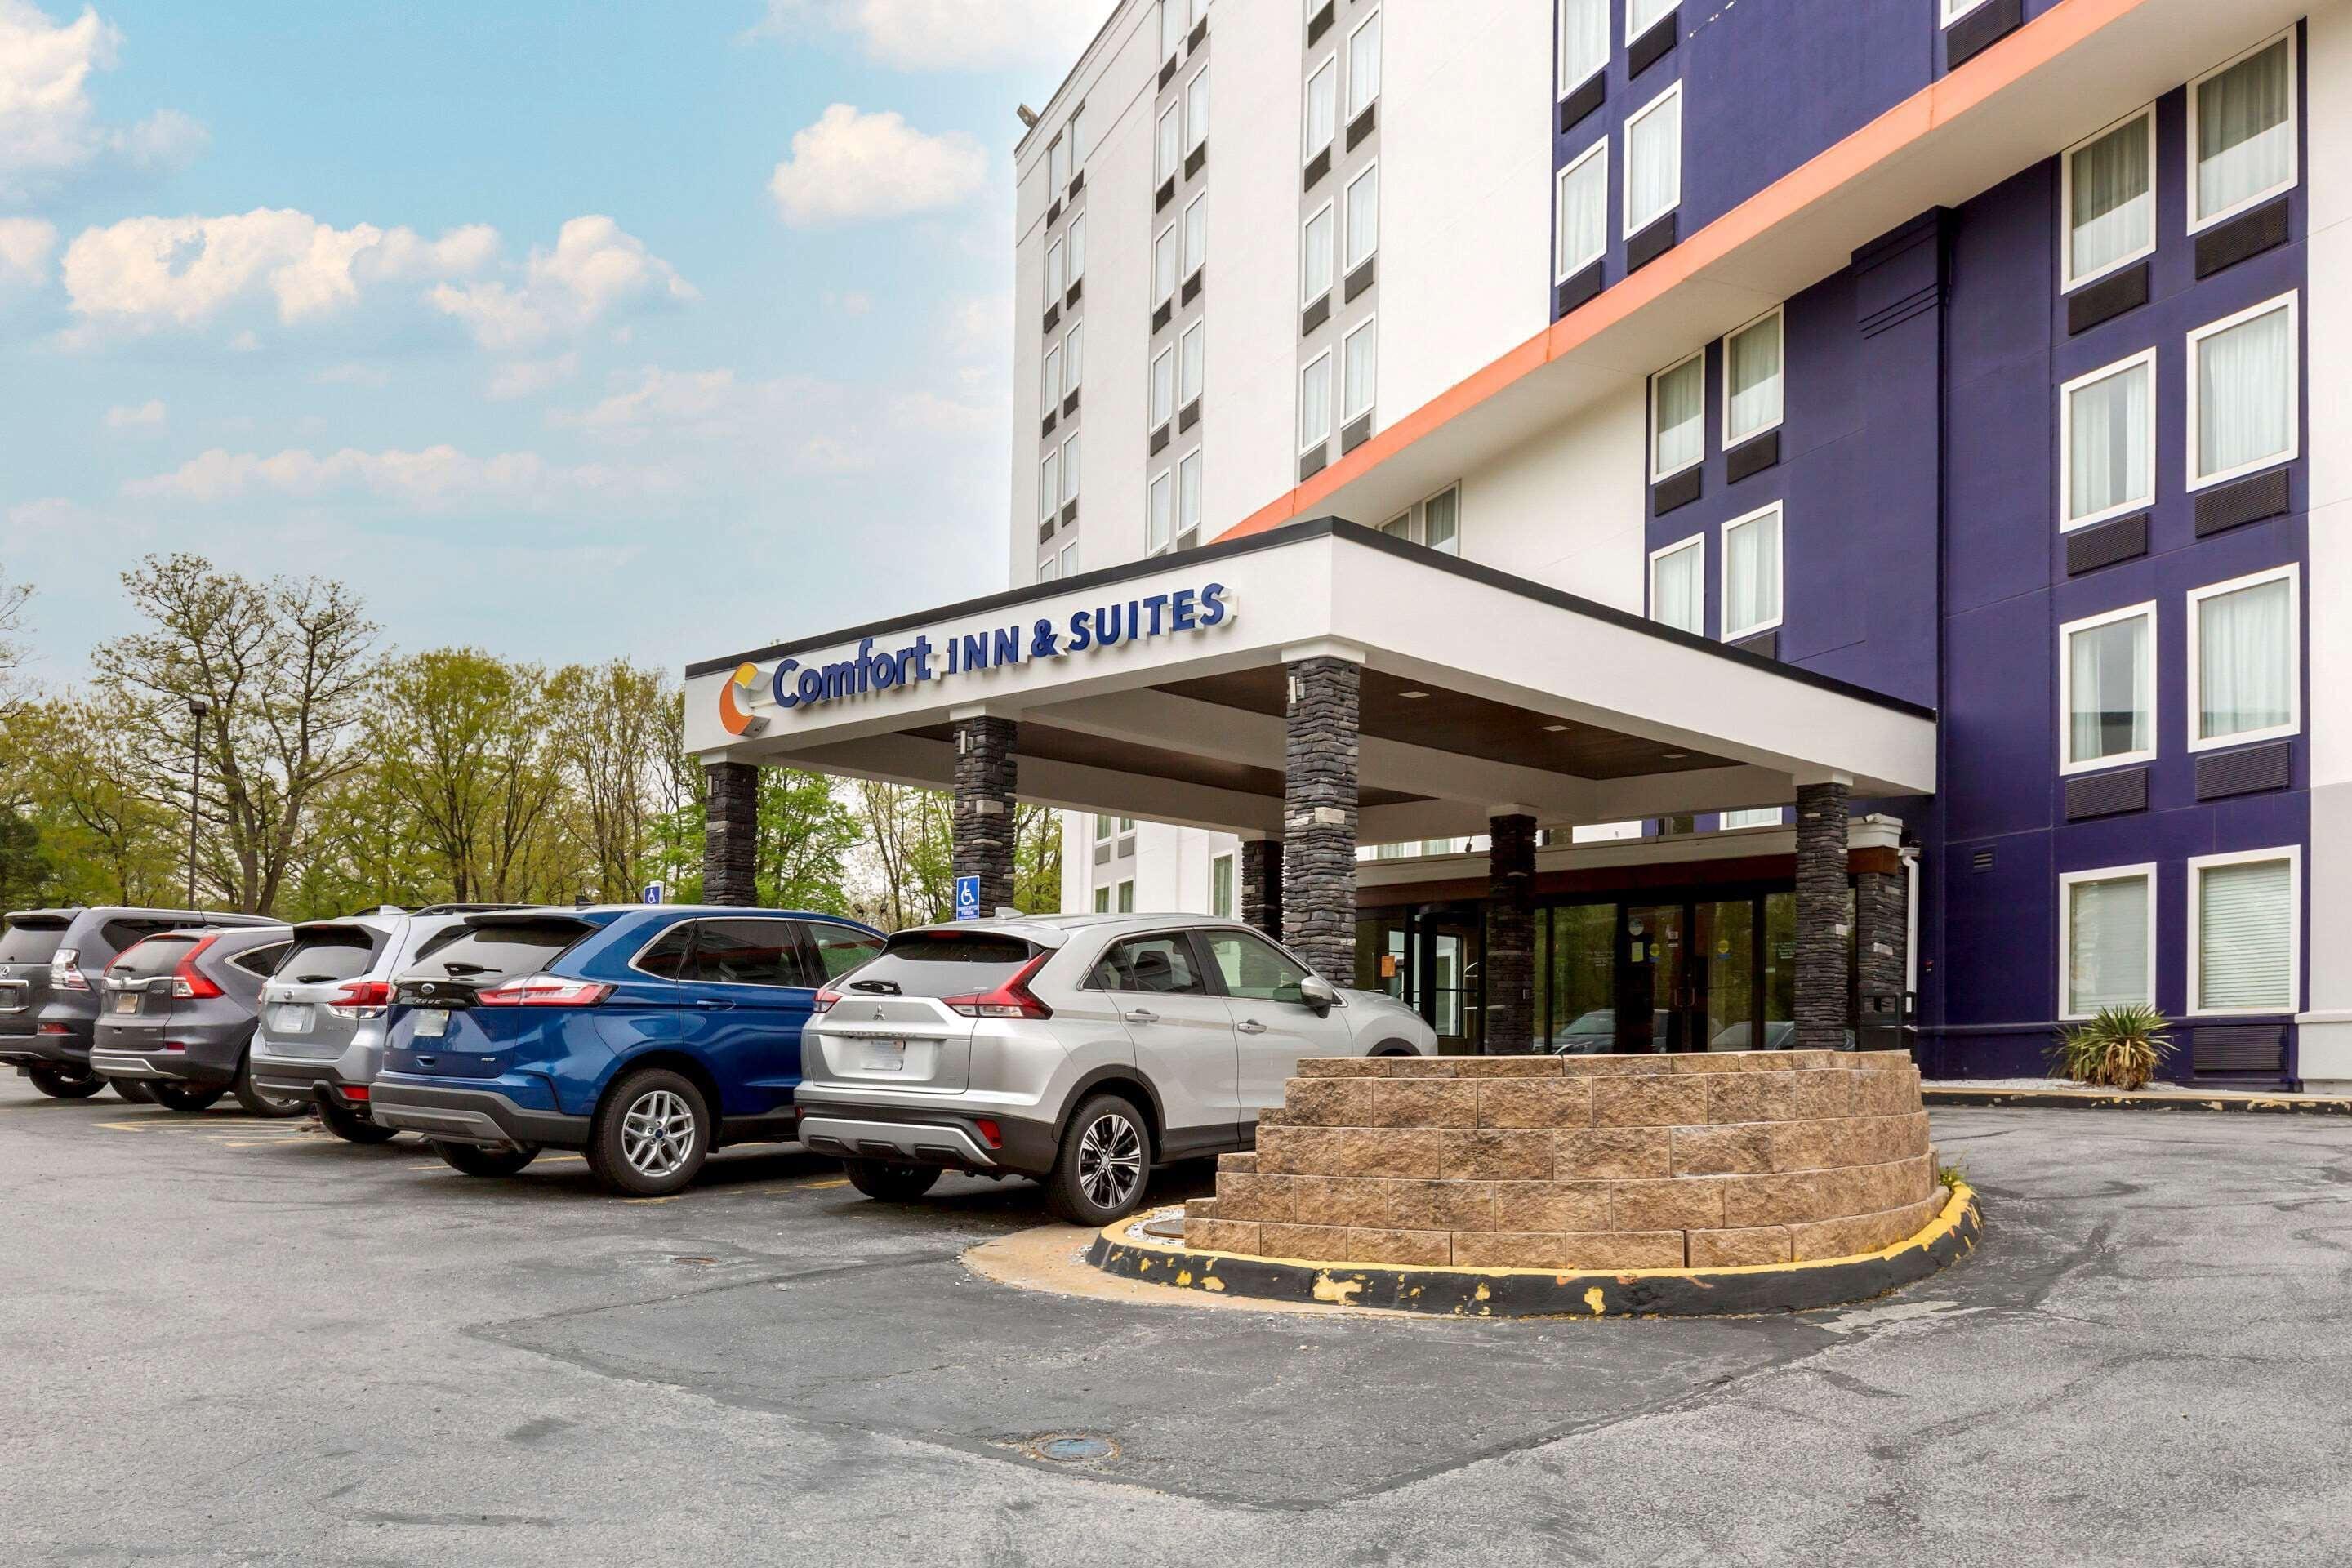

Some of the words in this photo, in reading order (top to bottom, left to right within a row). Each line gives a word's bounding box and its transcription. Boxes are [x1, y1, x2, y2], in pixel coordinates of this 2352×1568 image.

[773, 635, 931, 708] Comfort
[948, 626, 1019, 674] INN
[1031, 618, 1059, 658] &
[1068, 582, 1225, 651] SUITES
